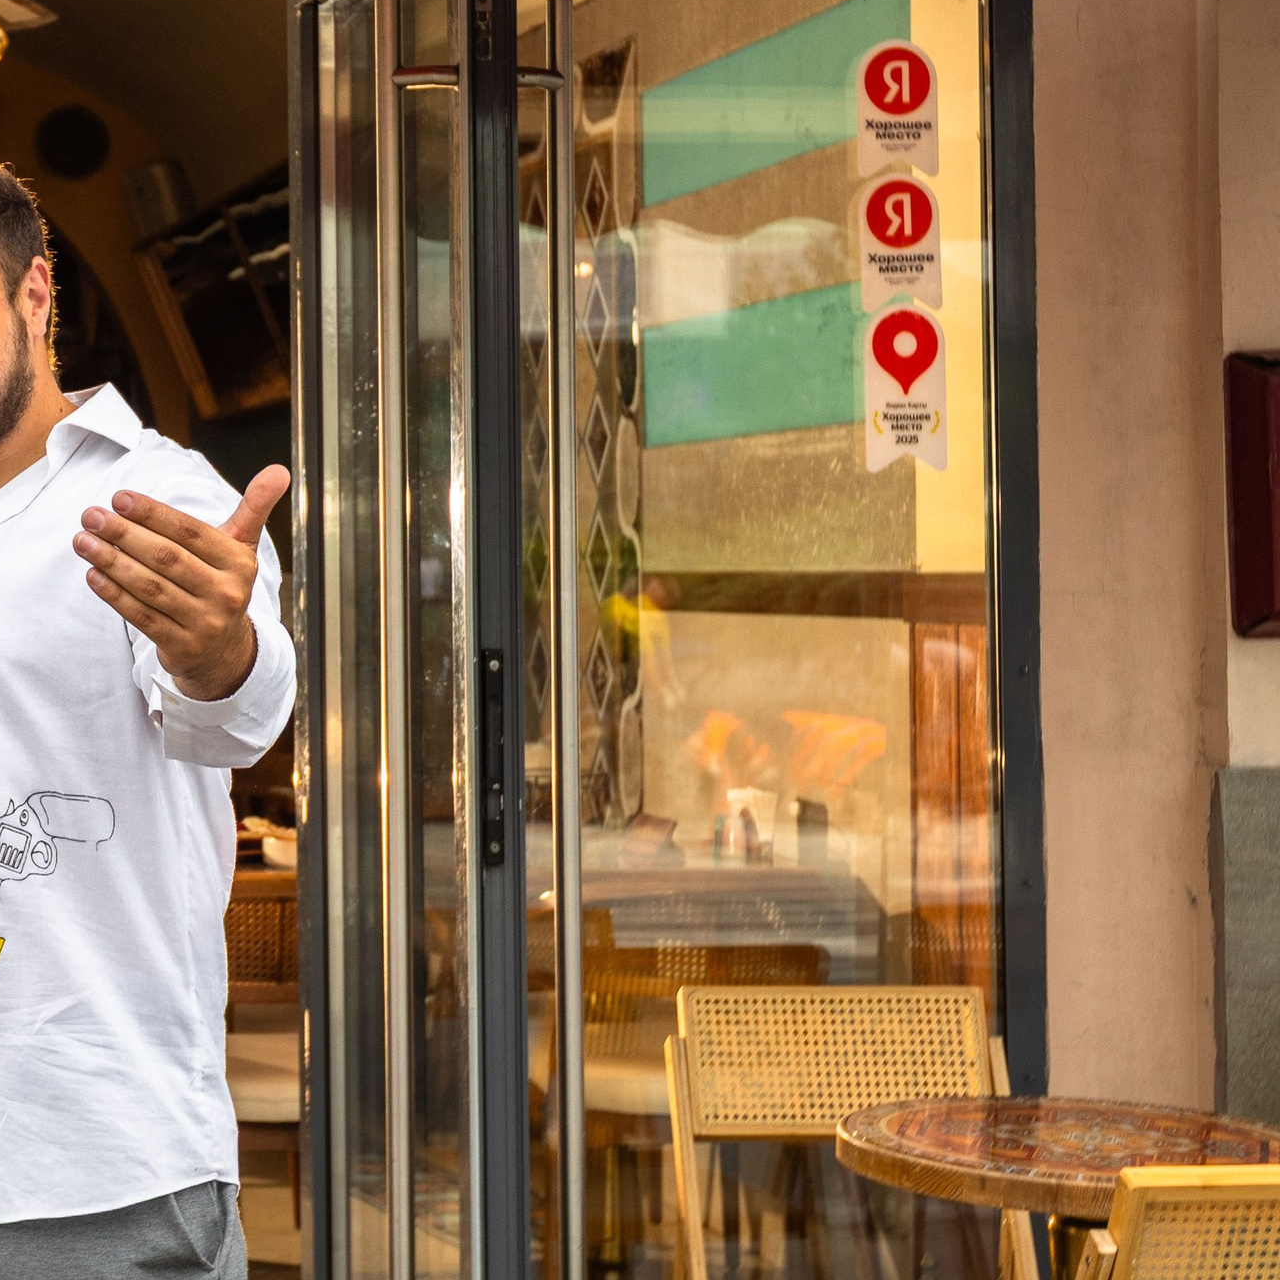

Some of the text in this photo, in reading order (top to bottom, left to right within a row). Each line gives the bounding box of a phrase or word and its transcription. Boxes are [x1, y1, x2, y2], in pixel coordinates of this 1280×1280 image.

[865, 119, 932, 131] Хорошее
[875, 131, 922, 140] место
[868, 253, 935, 264] Хорошее
[878, 264, 924, 273] место
[883, 411, 931, 423] Хорошее
[891, 423, 923, 431] место
[895, 434, 919, 445] 2025
